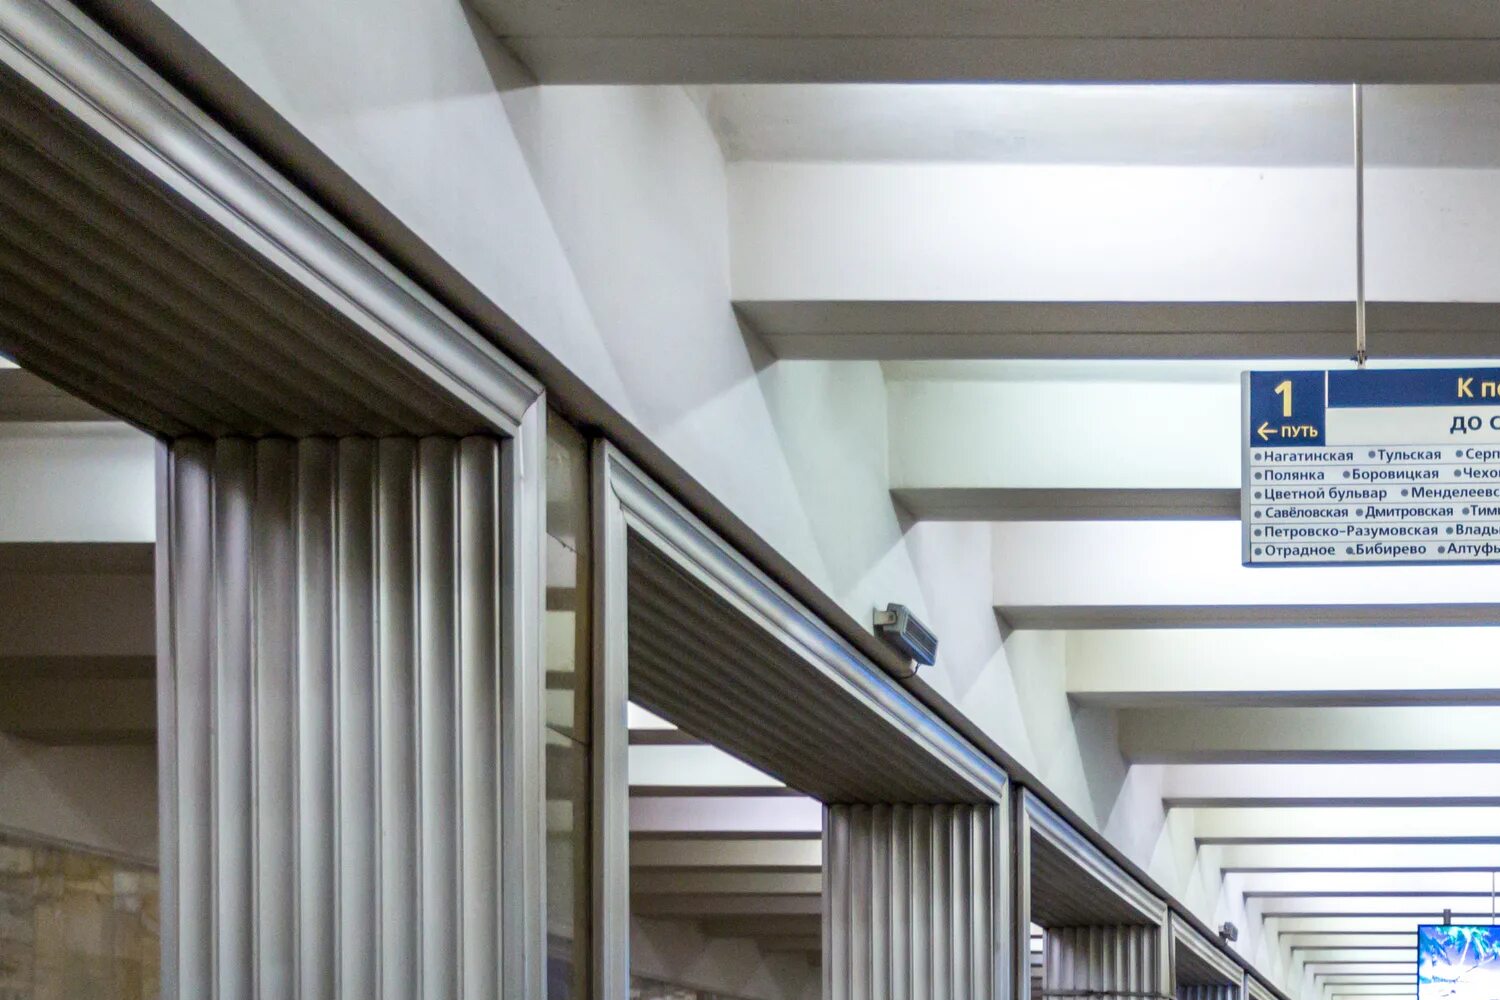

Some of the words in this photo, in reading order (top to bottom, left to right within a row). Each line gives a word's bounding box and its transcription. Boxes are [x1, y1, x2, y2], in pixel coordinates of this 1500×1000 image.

[1458, 377, 1474, 398] К
[1274, 380, 1292, 417] 1
[1281, 425, 1318, 438] ПУТЬ
[1450, 415, 1482, 434] до
[1264, 451, 1354, 462] Нагатинская
[1377, 449, 1441, 463] Тульская
[1264, 469, 1325, 481] Полянка
[1352, 468, 1439, 482] Боровицкая
[1265, 487, 1325, 501] Цветной
[1328, 487, 1387, 501] бульвар
[1265, 507, 1349, 519] Савёловская
[1365, 506, 1453, 519] Дмитровская
[1264, 525, 1438, 540] Петровско-Разумовская
[1265, 545, 1336, 558] Отрадное
[1356, 544, 1427, 557] Бибирево
